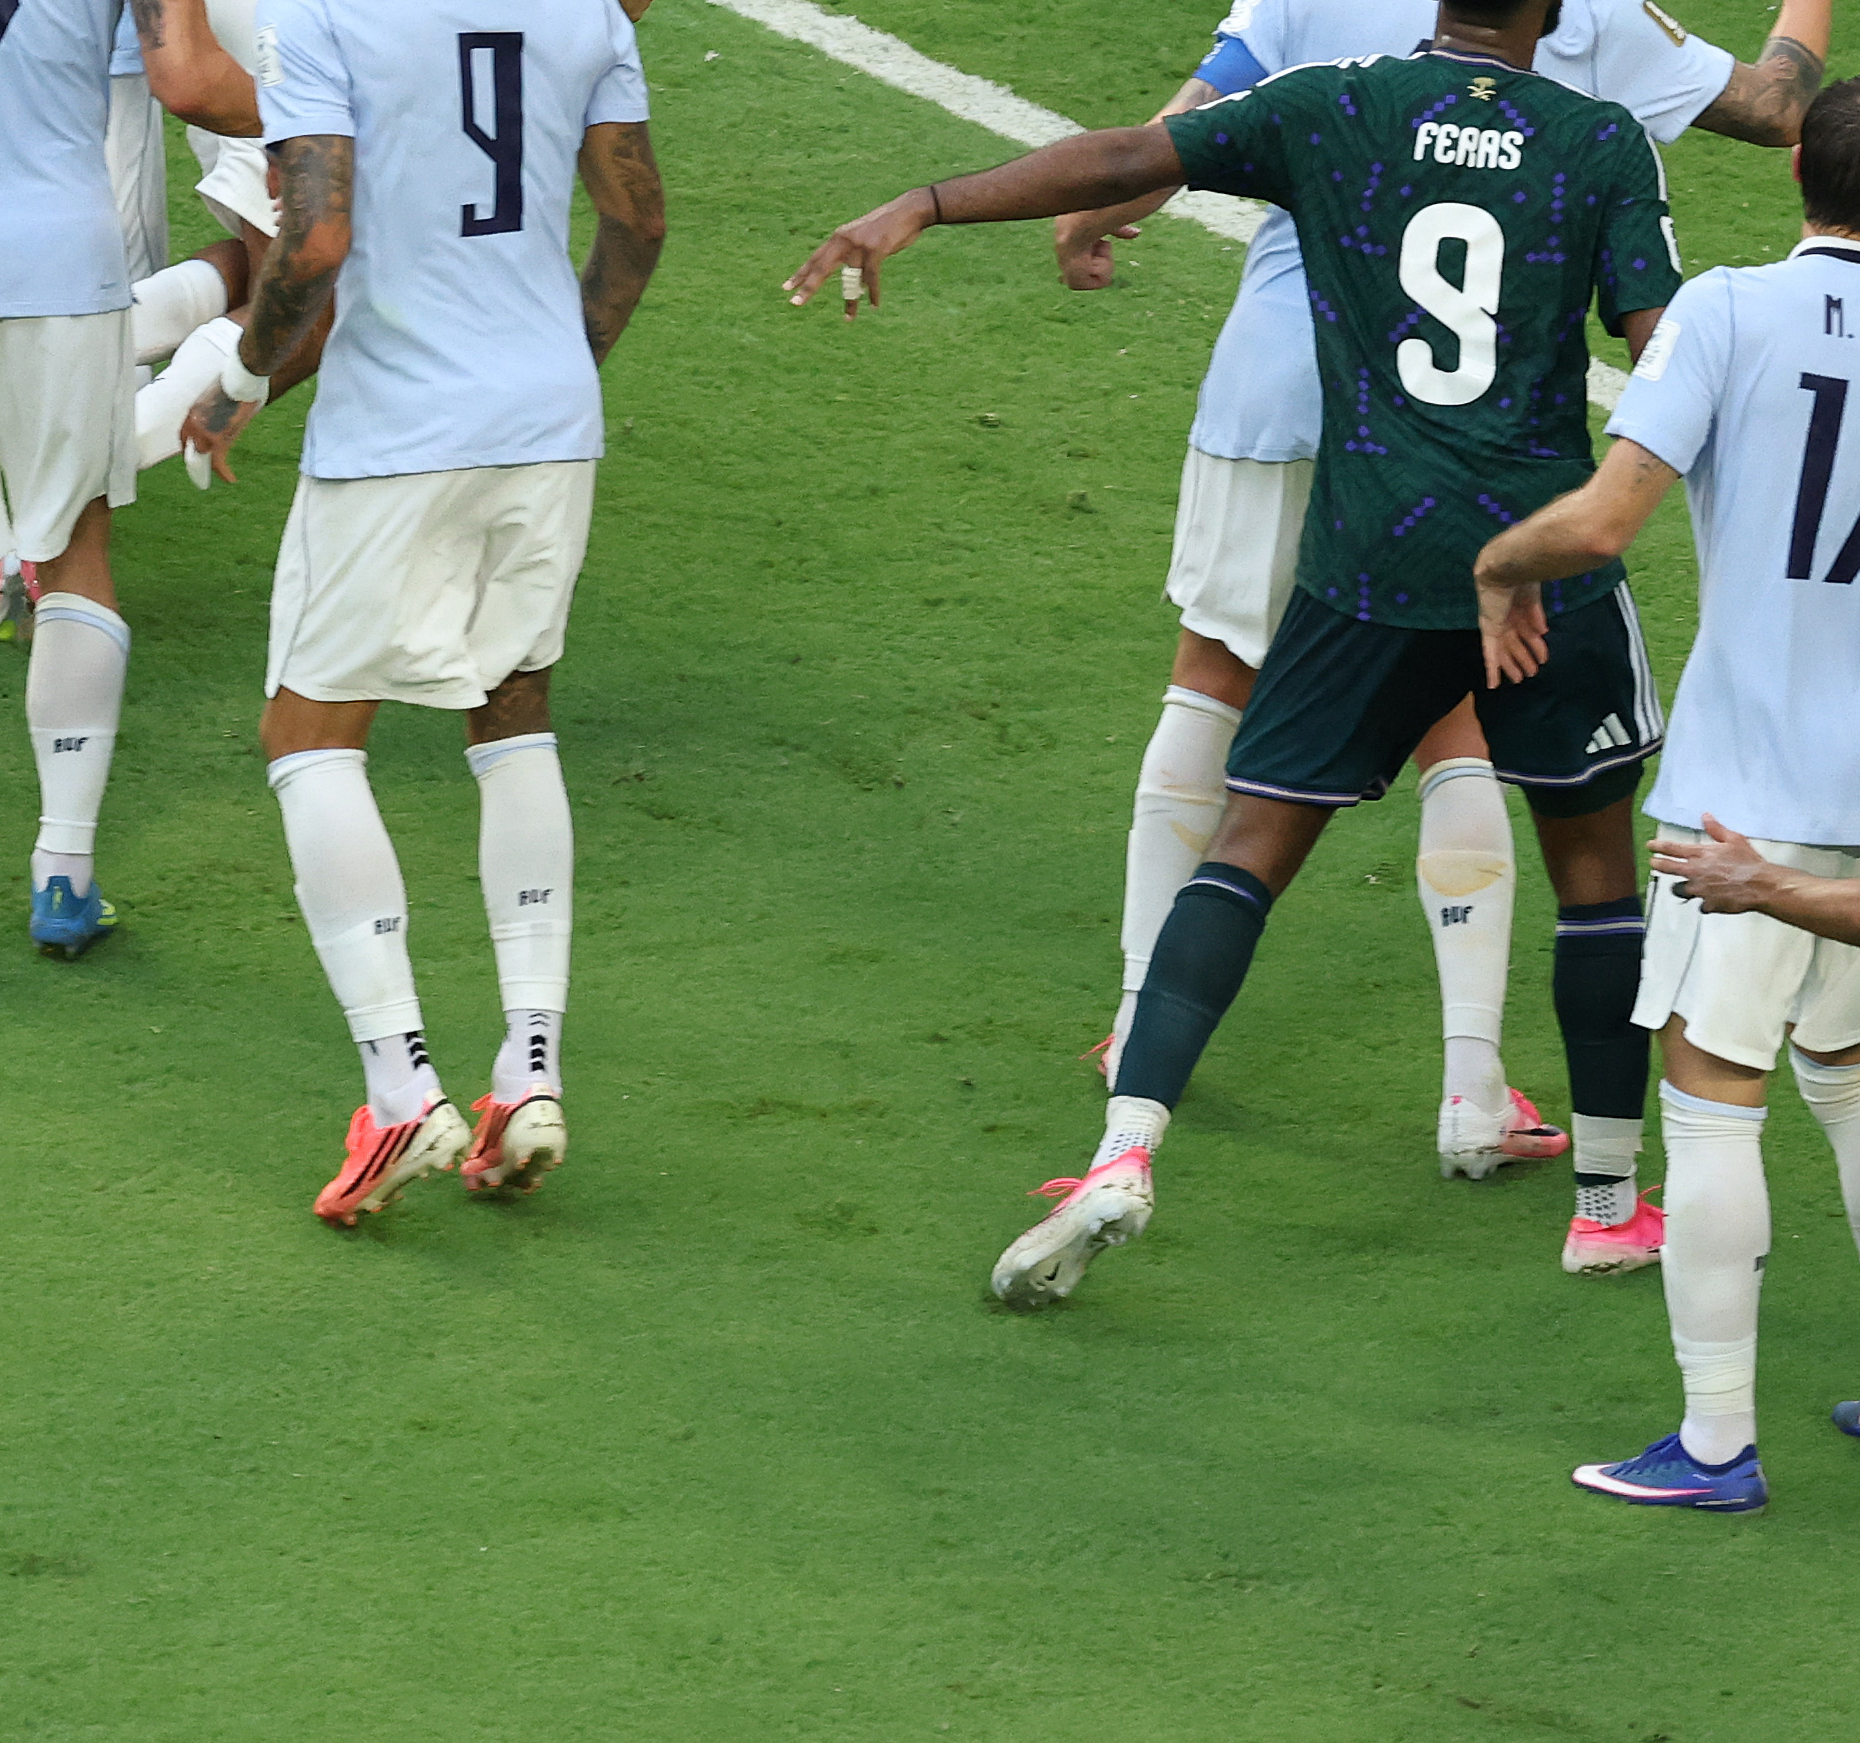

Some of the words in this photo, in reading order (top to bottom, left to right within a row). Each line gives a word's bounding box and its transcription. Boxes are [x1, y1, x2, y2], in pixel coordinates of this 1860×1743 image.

[457, 30, 524, 238] 9
[1412, 121, 1525, 170] FERAS
[1396, 201, 1505, 406] 9
